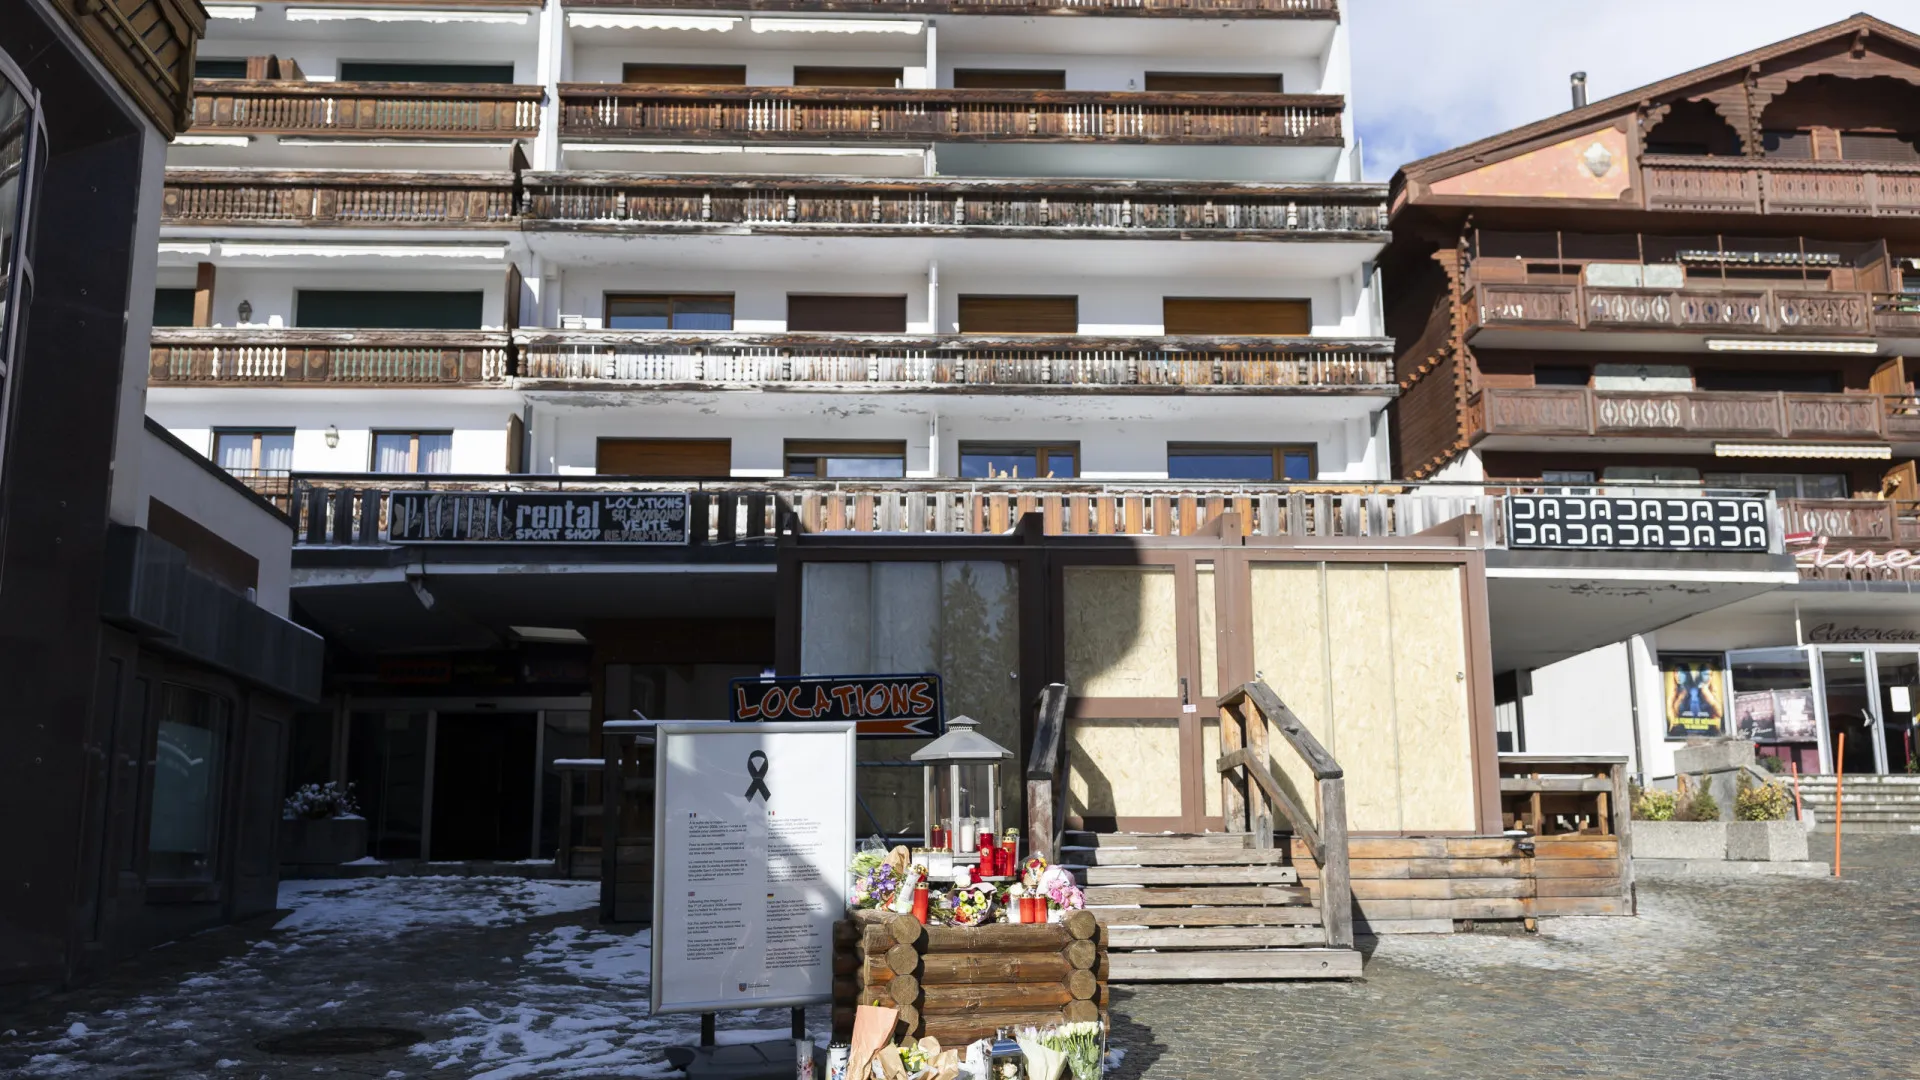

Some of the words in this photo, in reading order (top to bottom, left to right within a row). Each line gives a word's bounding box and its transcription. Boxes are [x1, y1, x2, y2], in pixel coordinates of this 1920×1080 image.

[605, 496, 684, 510] LOCATIONS
[515, 499, 600, 529] rental
[621, 520, 672, 531] VENTE
[515, 528, 560, 541] SPORT
[564, 528, 601, 541] SHOP
[737, 682, 934, 719] LOCATIONS
